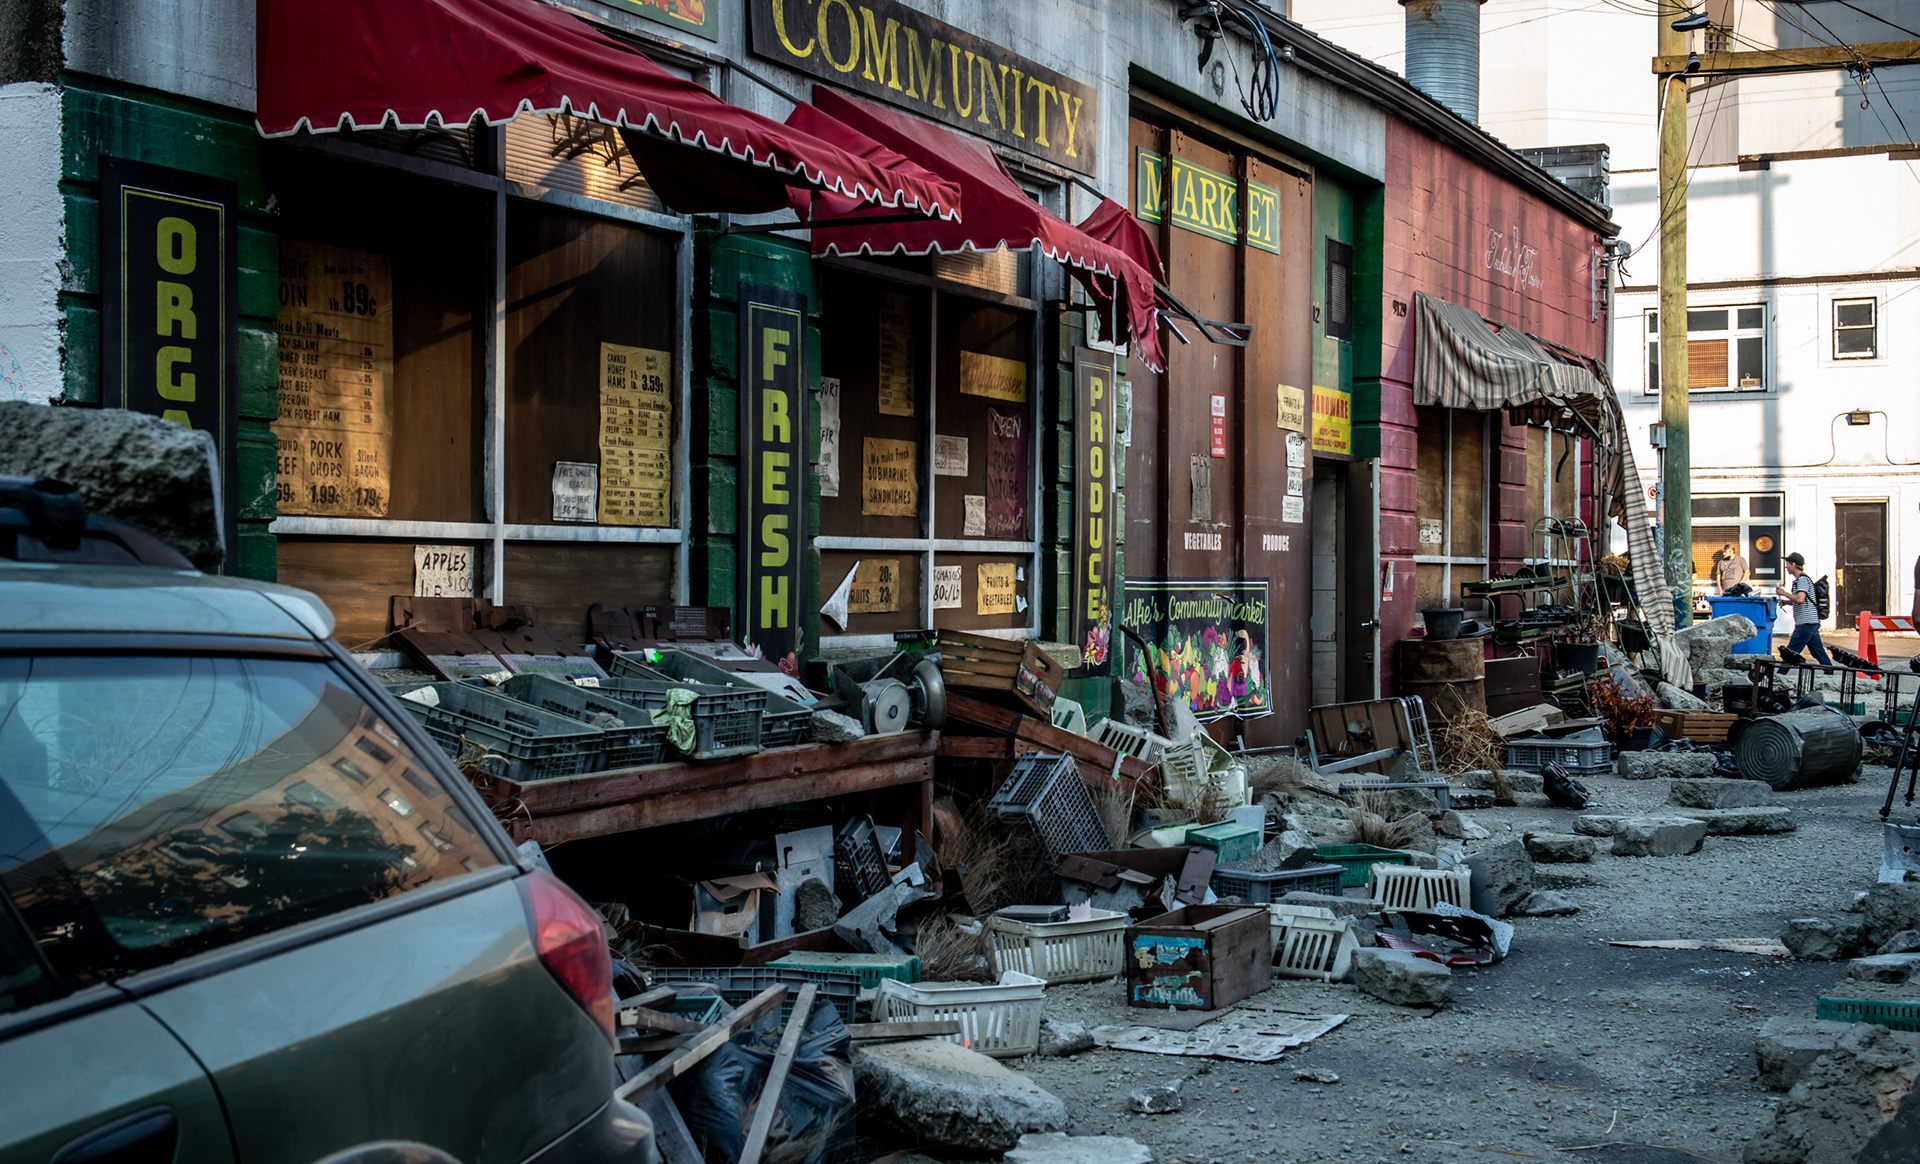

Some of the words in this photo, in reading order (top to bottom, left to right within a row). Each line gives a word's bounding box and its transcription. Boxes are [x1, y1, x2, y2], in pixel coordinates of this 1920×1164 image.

[772, 0, 1083, 158] COMMUNITY
[1144, 160, 1275, 242] MARKET
[343, 281, 376, 317] 89¢
[296, 320, 312, 334] Deli
[316, 323, 339, 338] Meats
[302, 353, 319, 365] BEEF
[607, 353, 626, 364] CANNED
[300, 367, 327, 380] BREAST
[607, 364, 626, 376] HONEY
[295, 381, 312, 392] BEEF
[607, 376, 626, 390] HAMS
[294, 408, 320, 421] FOREST
[323, 411, 340, 422] HAM
[992, 414, 1021, 438] OPEN
[310, 440, 343, 459] PORK
[895, 446, 909, 460] Fresh
[310, 461, 342, 478] CHOPS
[760, 327, 791, 629] FRESH
[868, 466, 907, 483] SUBMARINE
[868, 488, 911, 505] SANDWICHES
[1087, 376, 1104, 620] PRODUCE
[1184, 532, 1222, 551] VEGETABLES
[1262, 533, 1290, 551] PRODUCE
[421, 552, 467, 572] APPLES
[987, 576, 1004, 589] FRUITS
[982, 593, 1012, 607] VEGETABLES
[1124, 595, 1164, 634] Alfie's
[1168, 592, 1223, 626] Community
